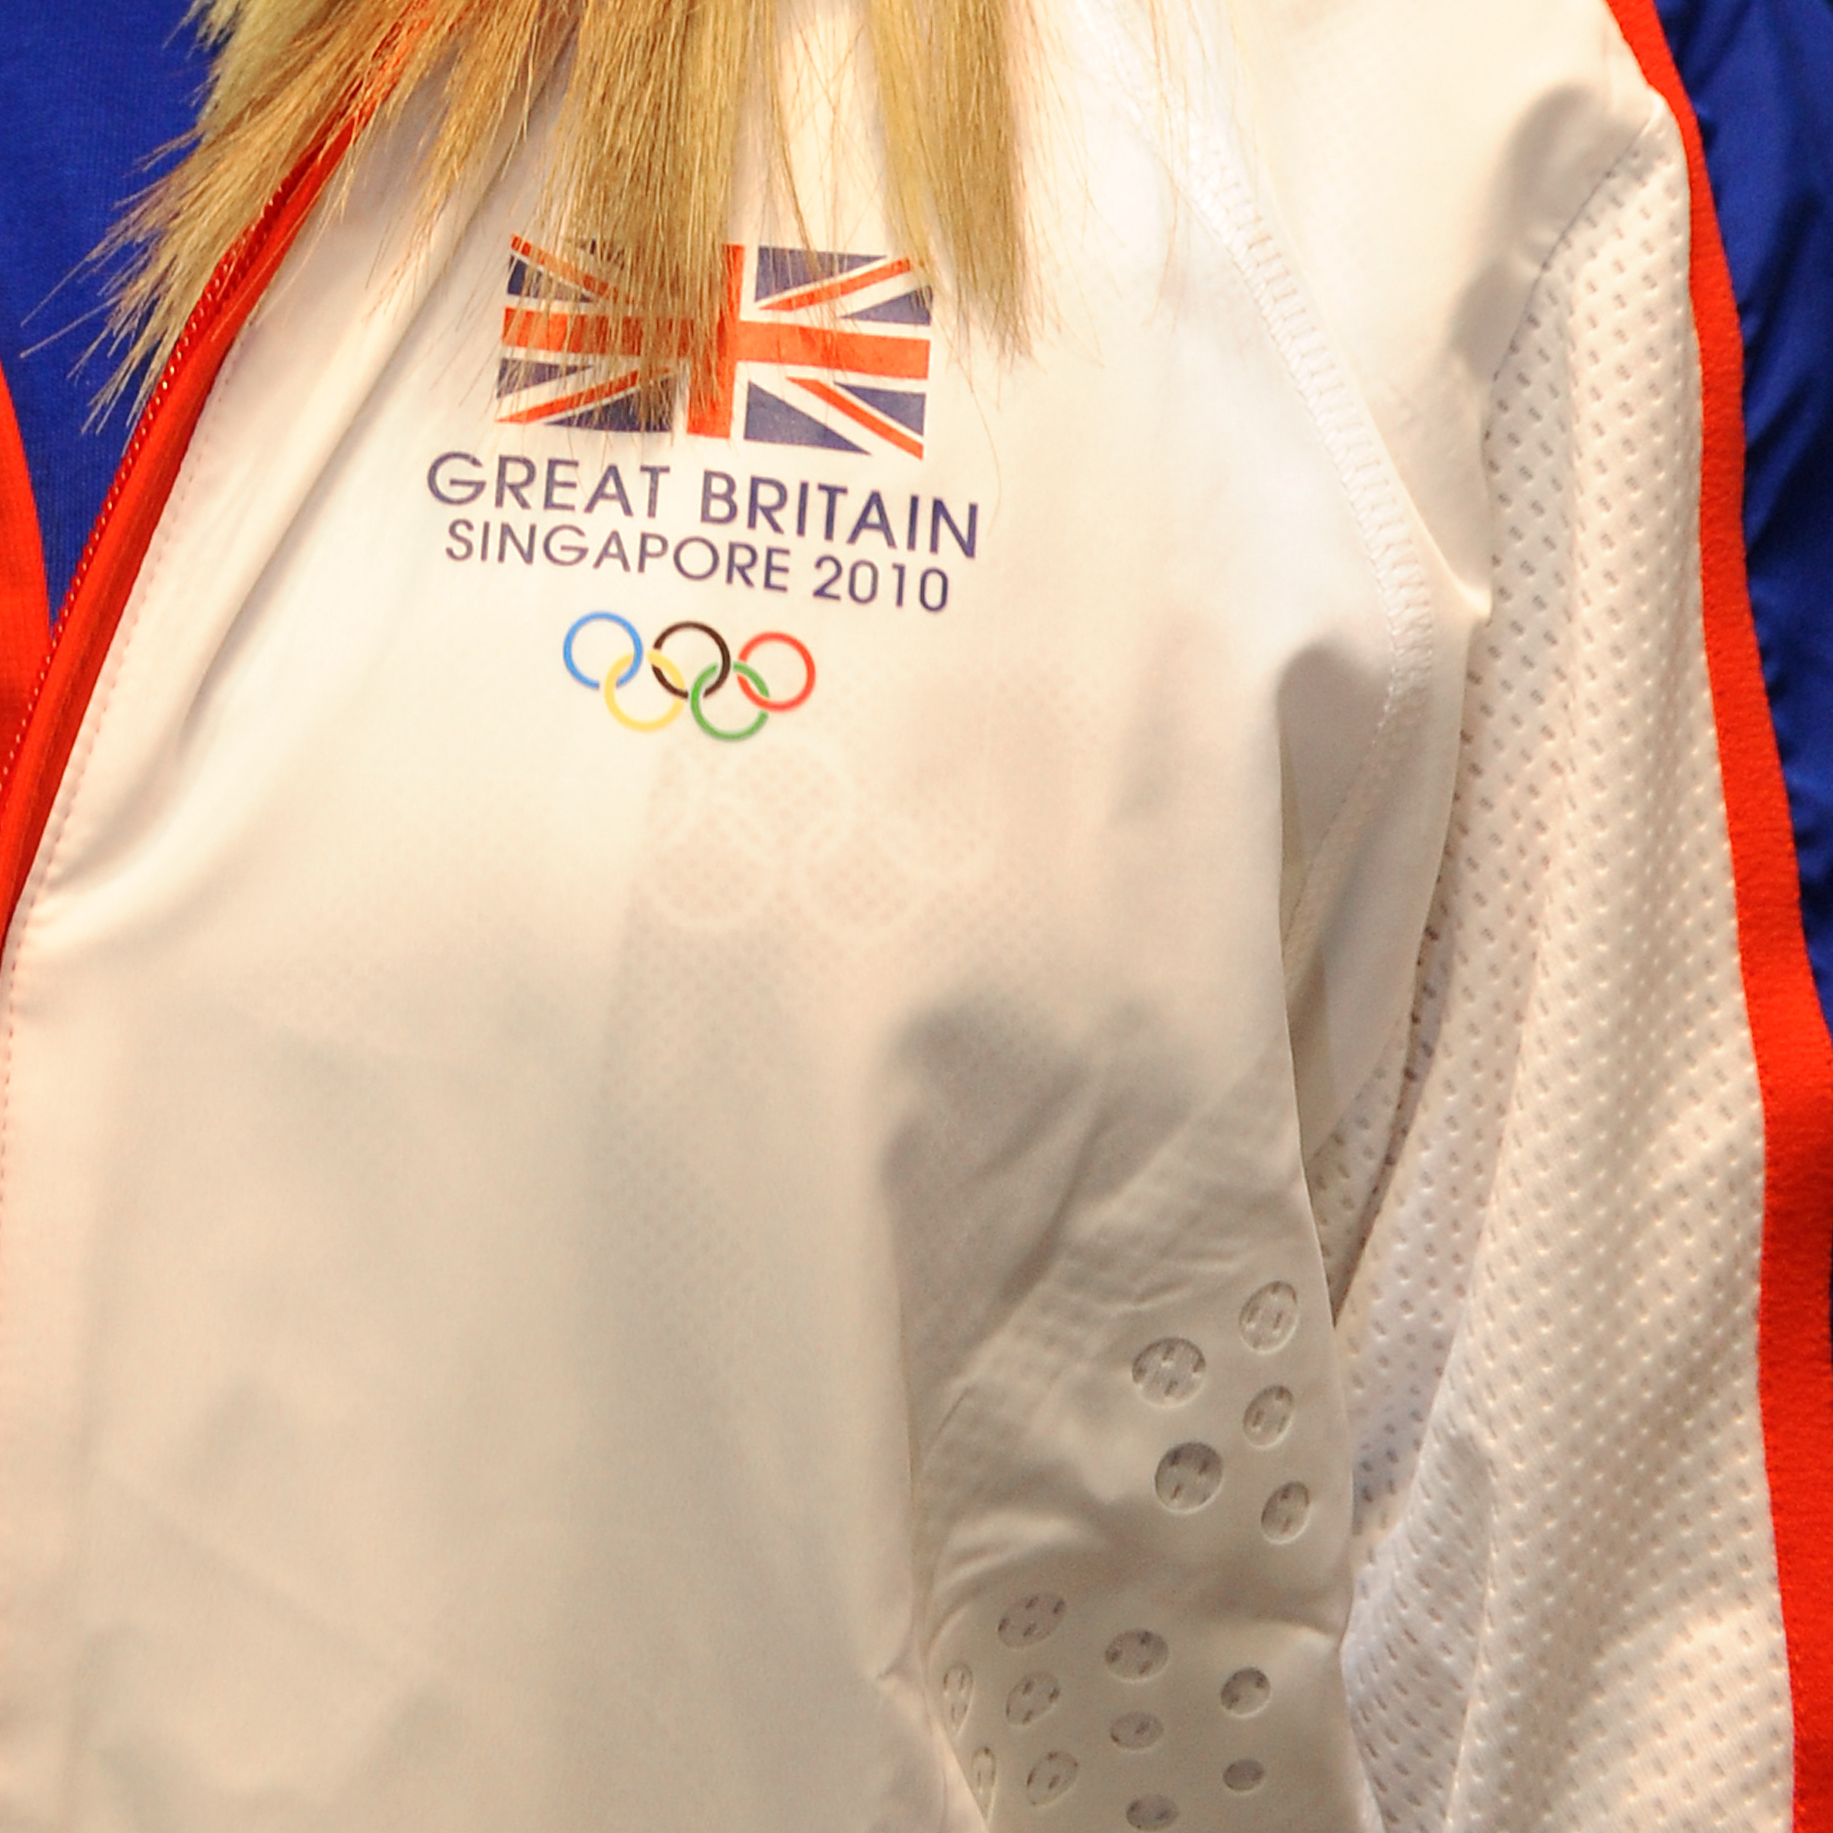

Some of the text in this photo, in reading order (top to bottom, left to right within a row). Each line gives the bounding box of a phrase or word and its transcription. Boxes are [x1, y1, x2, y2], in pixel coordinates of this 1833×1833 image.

[425, 450, 978, 560] GREAT BRITAIN
[444, 518, 950, 613] SINGAPORE 2010
